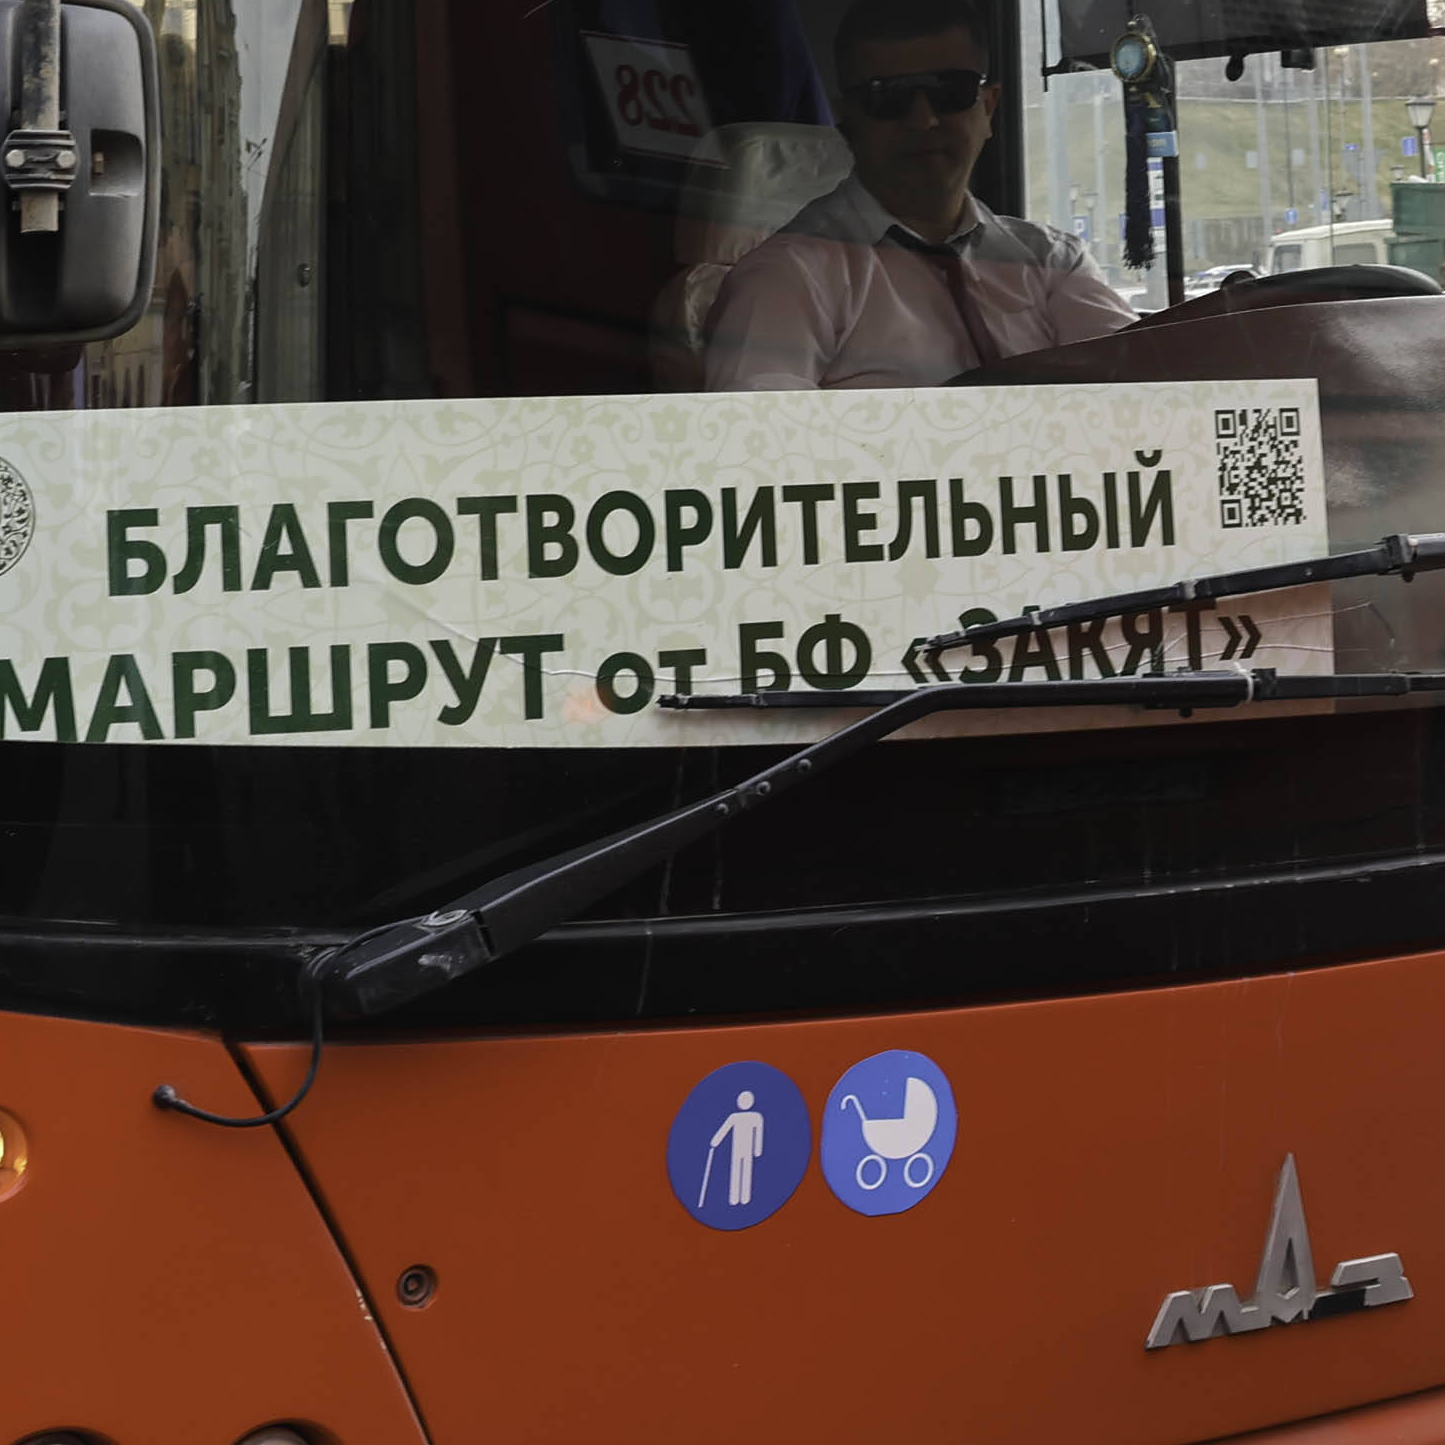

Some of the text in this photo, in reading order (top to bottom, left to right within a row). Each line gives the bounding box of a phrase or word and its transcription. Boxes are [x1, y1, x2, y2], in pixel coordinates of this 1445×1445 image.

[106, 448, 1178, 597] БЛАГОТВОРИТЕЛЬНЫЙ
[596, 648, 707, 715] от
[738, 613, 873, 694] БФ
